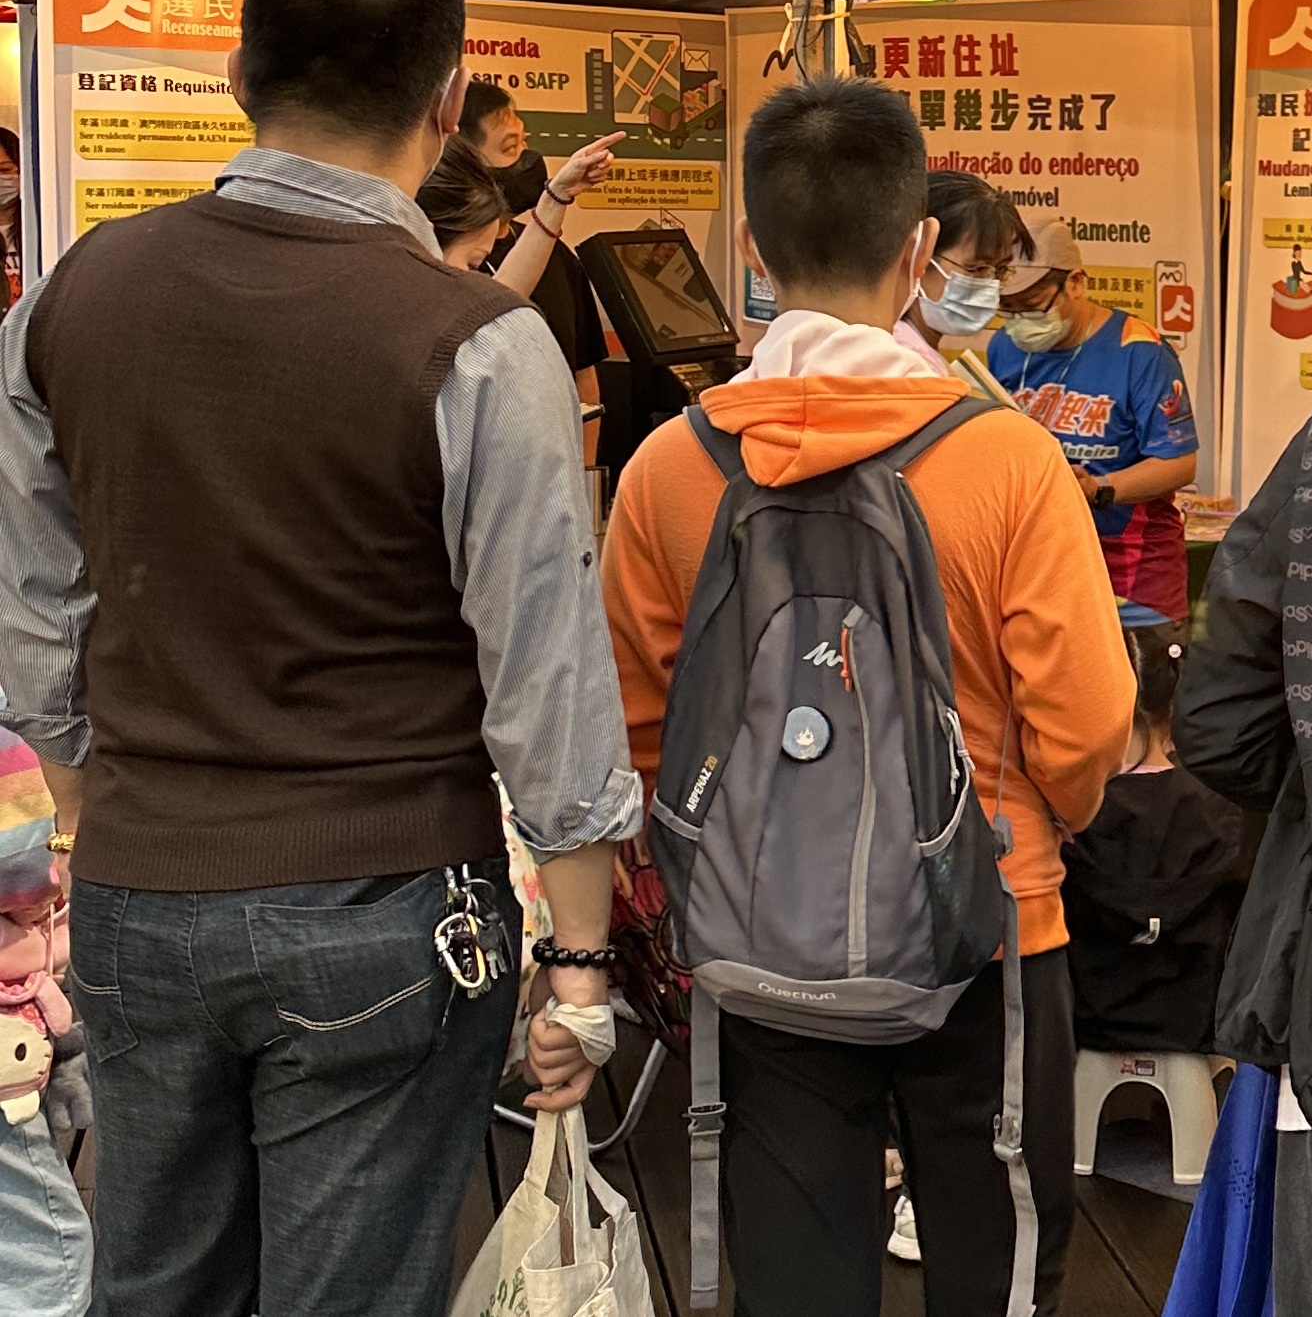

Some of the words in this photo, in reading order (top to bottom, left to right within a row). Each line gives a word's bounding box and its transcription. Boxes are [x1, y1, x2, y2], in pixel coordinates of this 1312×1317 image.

[162, 19, 241, 38] Recenseame
[857, 34, 1019, 79] 更新住址
[78, 73, 157, 92] 登記資格
[508, 74, 519, 89] o
[525, 71, 570, 90] SAFP
[903, 88, 1116, 131] 單幾步完成了
[927, 151, 1013, 179] ualização
[1019, 152, 1042, 175] do
[1049, 152, 1139, 181] endereço
